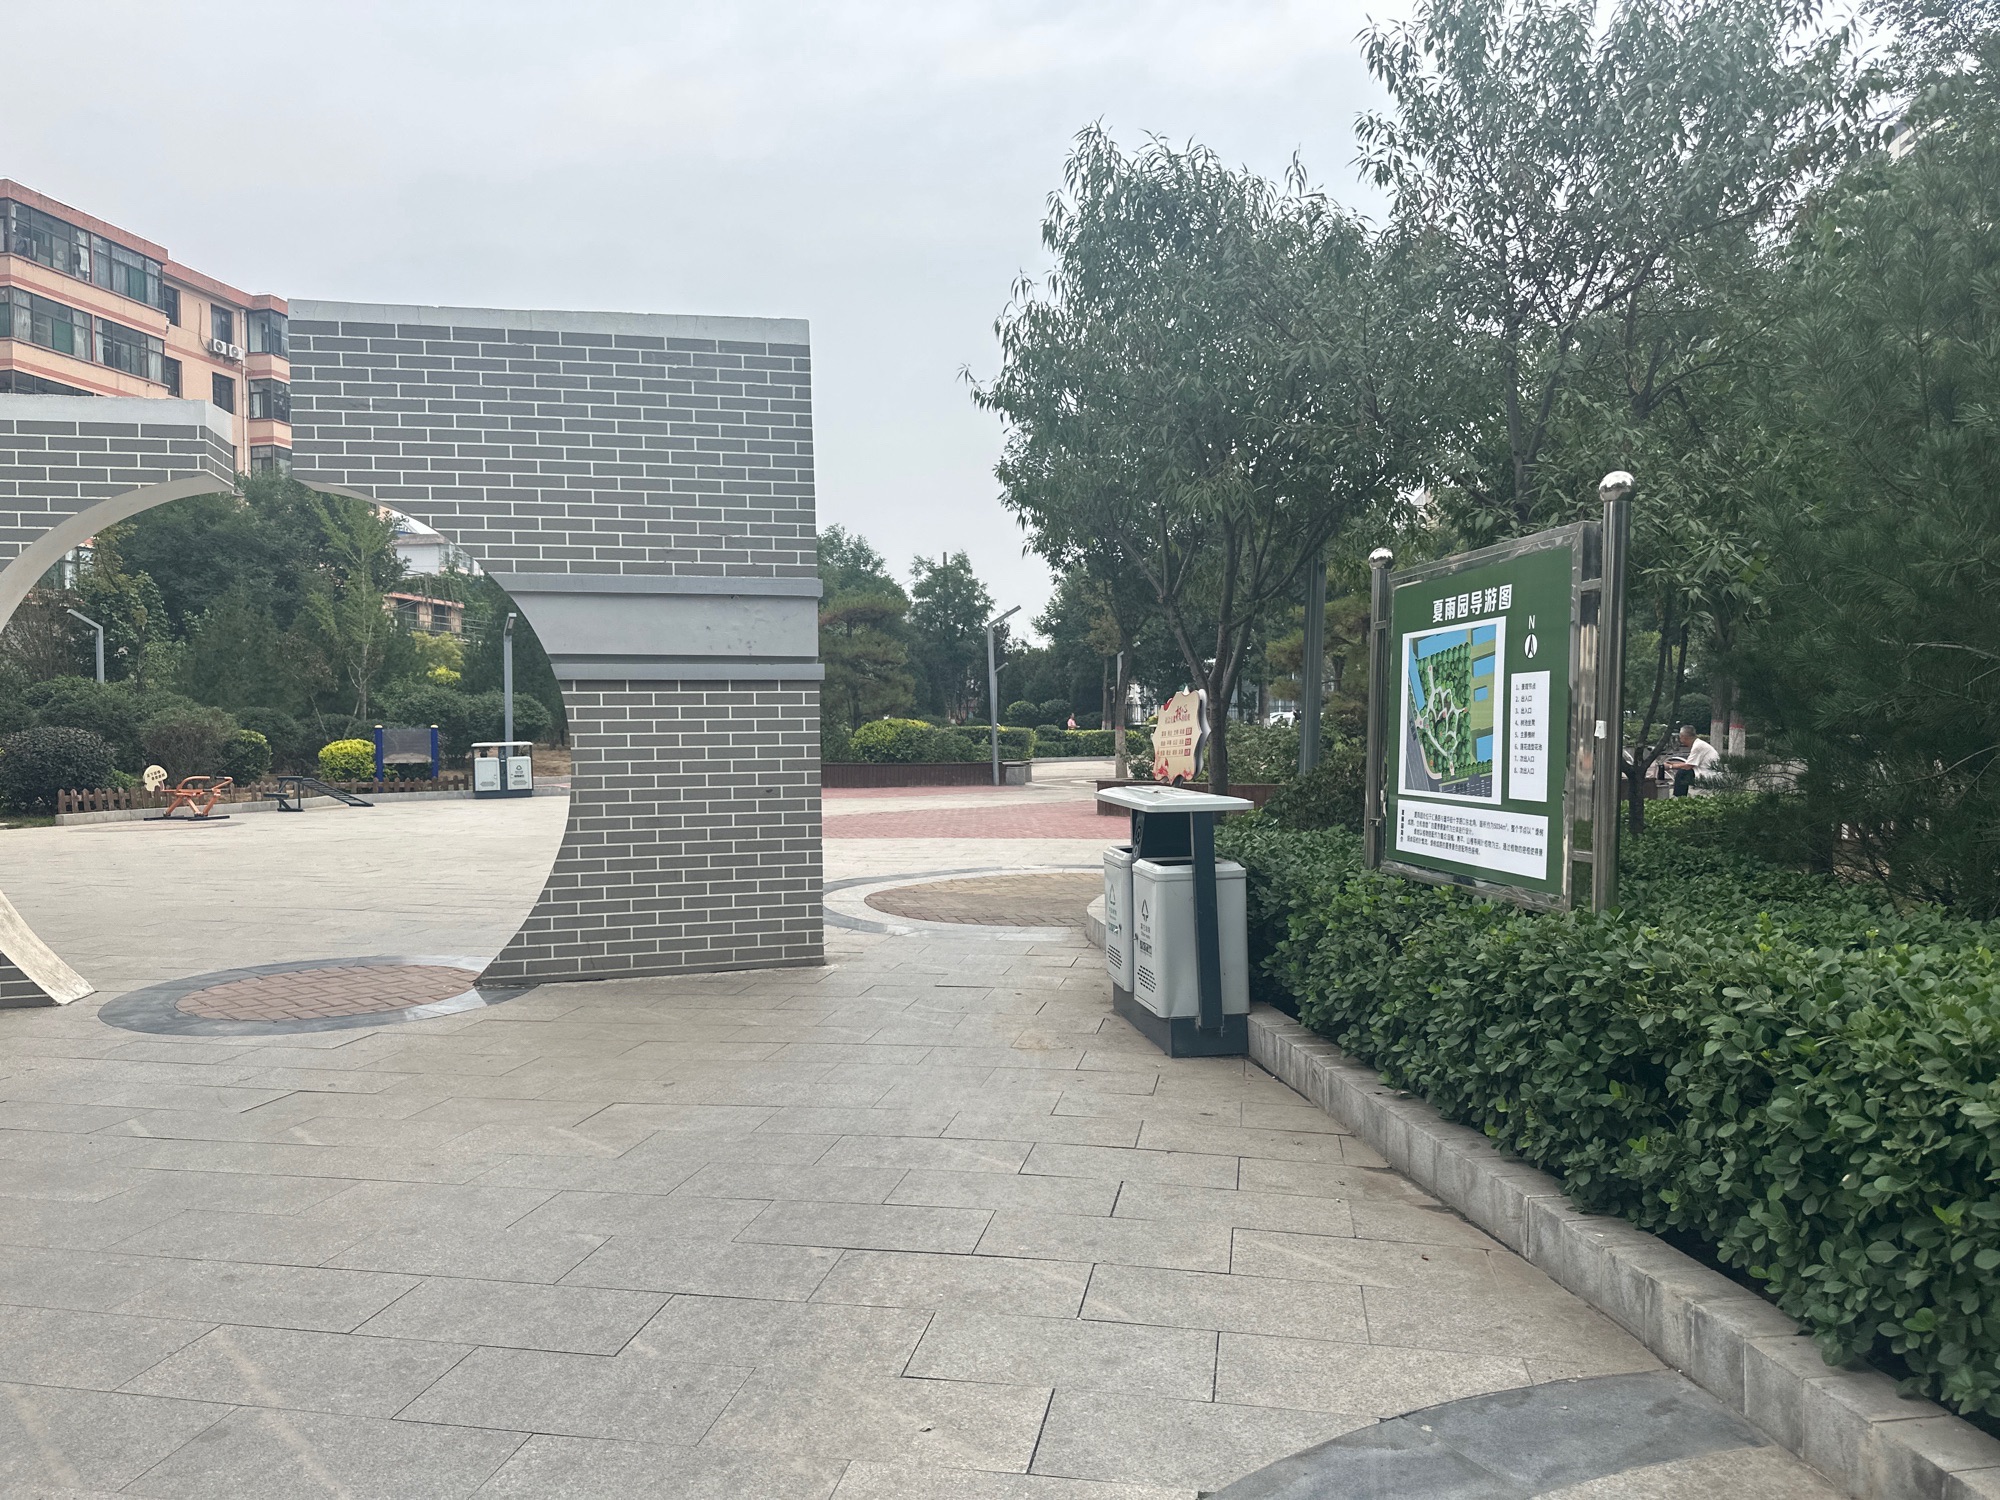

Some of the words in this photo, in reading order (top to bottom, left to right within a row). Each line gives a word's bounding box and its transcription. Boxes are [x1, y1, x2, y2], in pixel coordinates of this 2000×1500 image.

[1432, 583, 1513, 623] 夏雨园导游图
[1528, 615, 1536, 630] N
